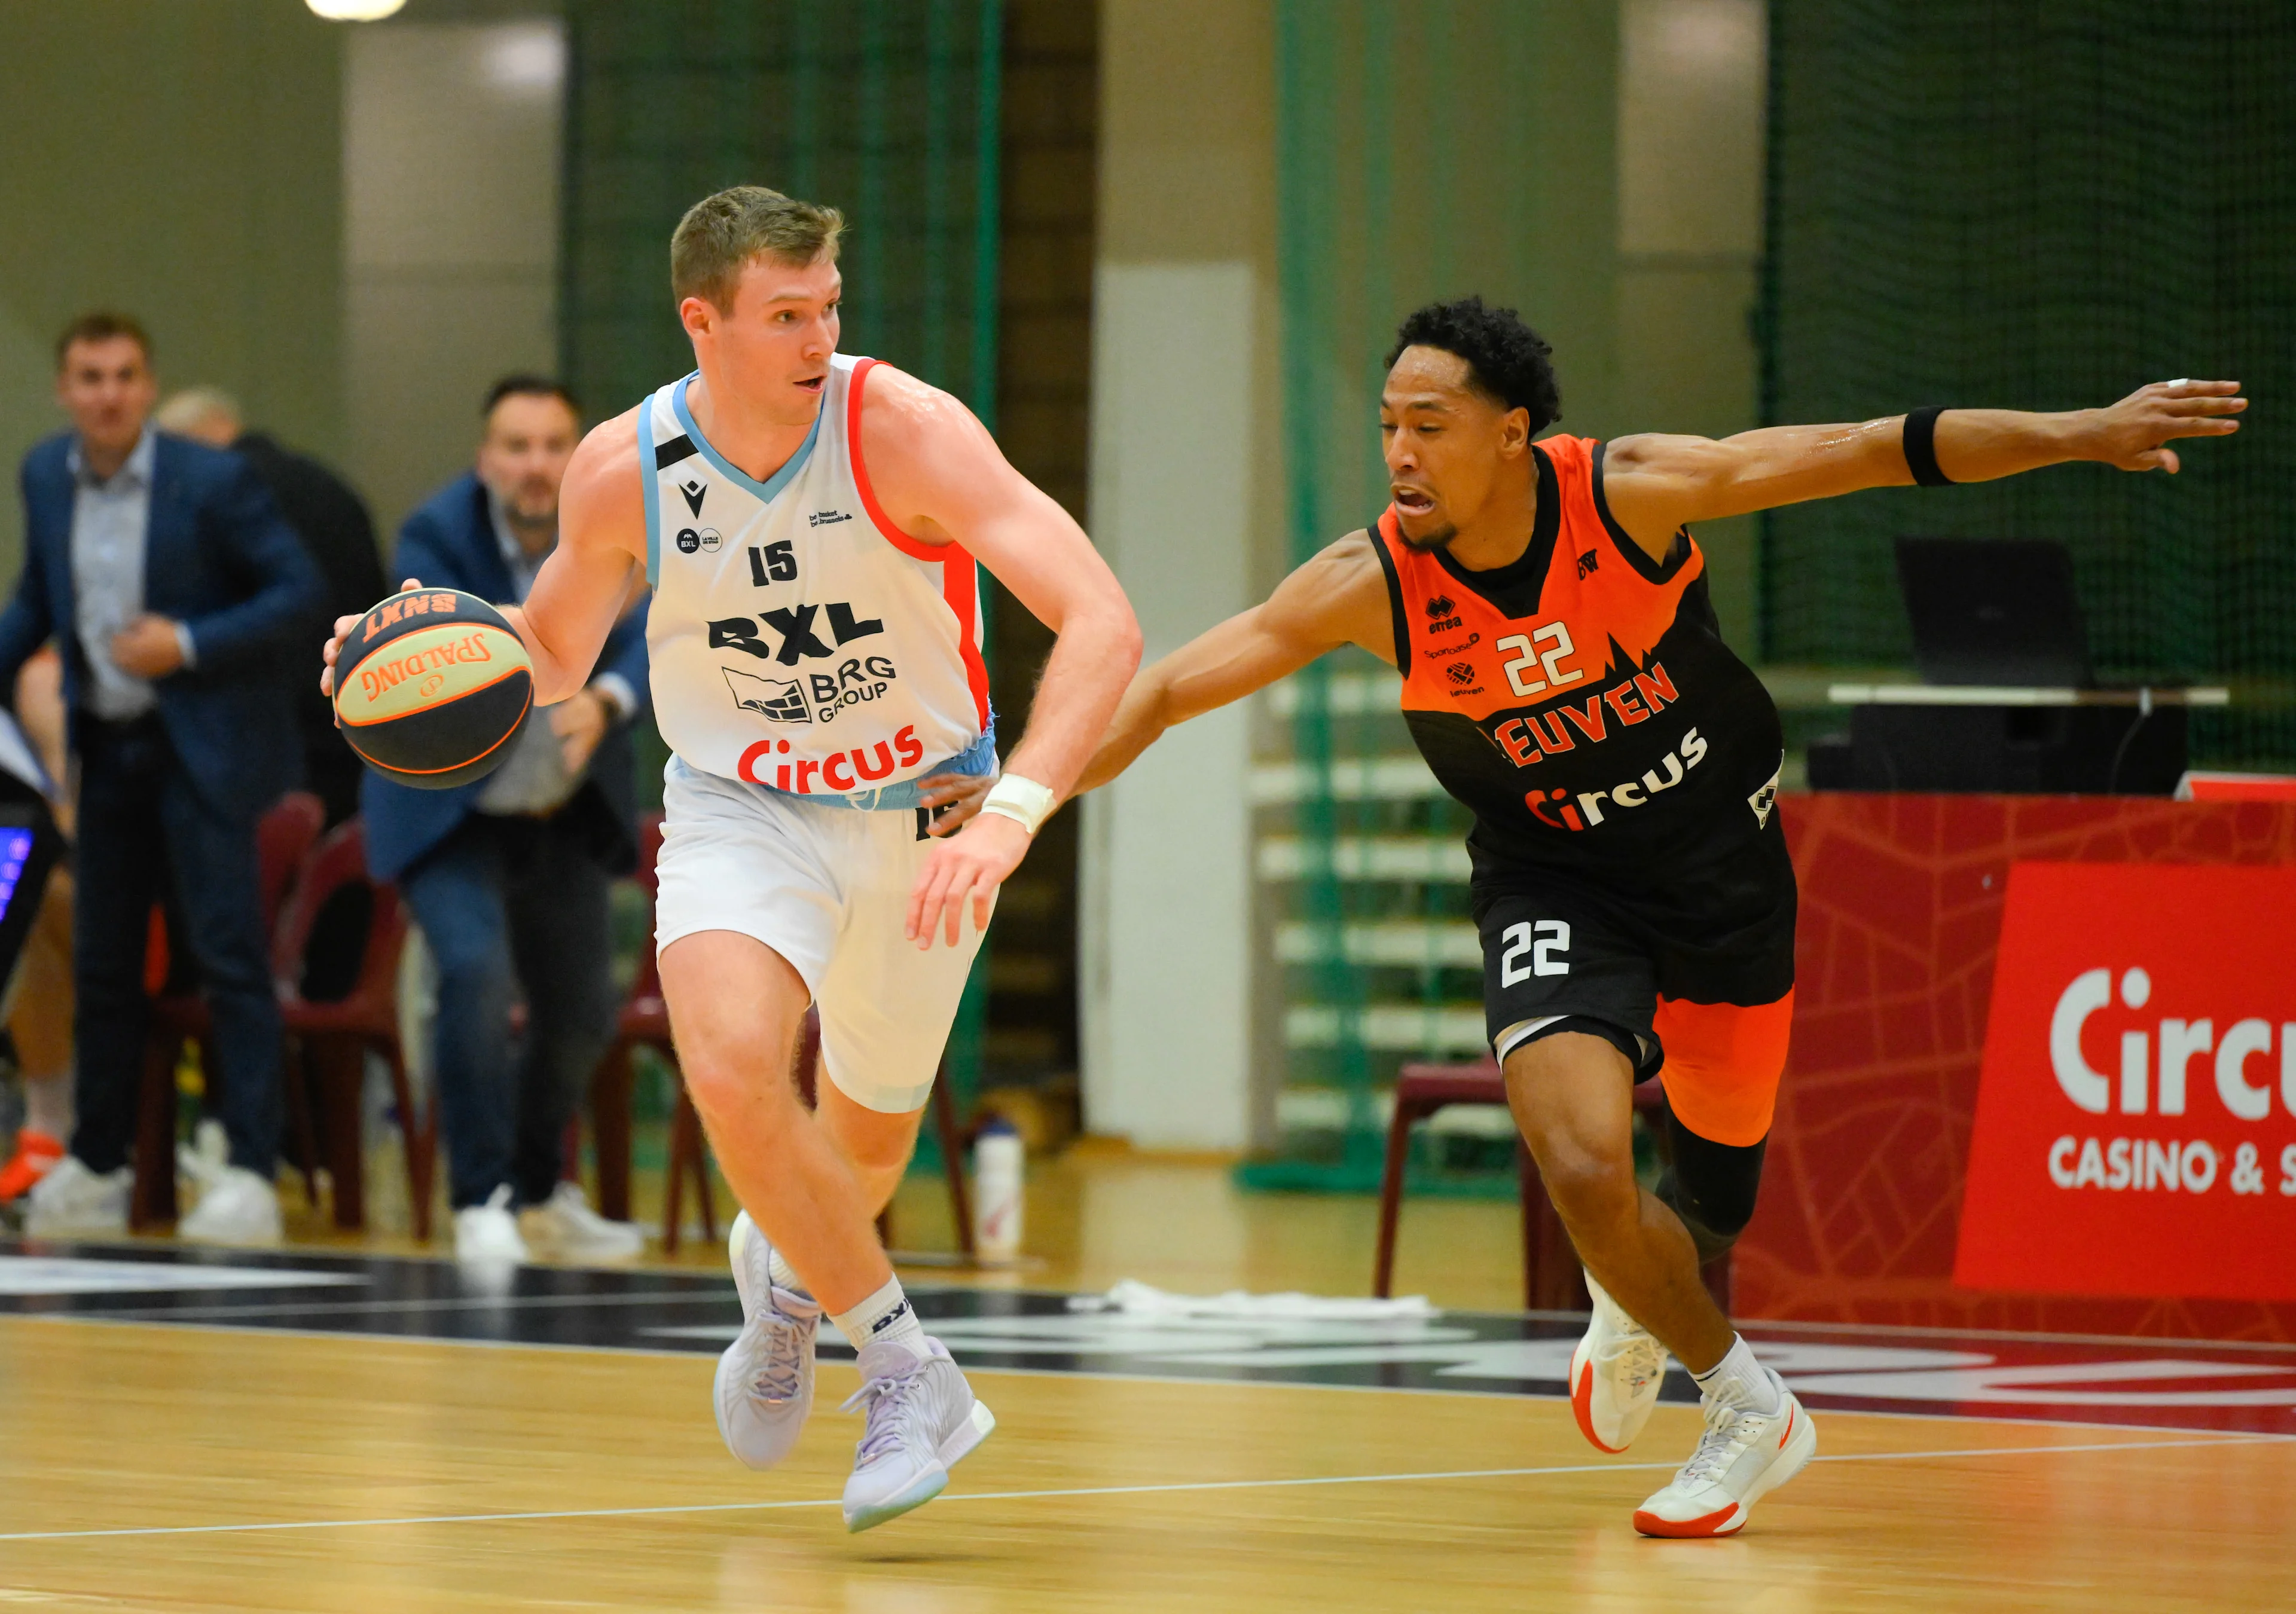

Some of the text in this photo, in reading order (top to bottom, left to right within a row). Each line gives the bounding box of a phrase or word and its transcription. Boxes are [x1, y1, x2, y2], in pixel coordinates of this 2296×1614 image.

[748, 540, 797, 587] 15
[362, 594, 456, 643] BNXT
[704, 602, 884, 667] BXL
[1428, 616, 1463, 634] errea
[361, 632, 491, 702] SPALDING
[809, 656, 896, 704] BRG
[1424, 643, 1472, 659] Sportoase
[1496, 620, 1584, 698] 22
[818, 681, 888, 723] GROUP
[1449, 686, 1485, 698] leuven
[1489, 661, 1680, 769] EUVEN
[737, 725, 923, 794] Circus
[1501, 919, 1571, 989] 22
[2050, 966, 2296, 1121] Circ
[2048, 1135, 2217, 1194] CASINO
[2230, 1141, 2265, 1196] &
